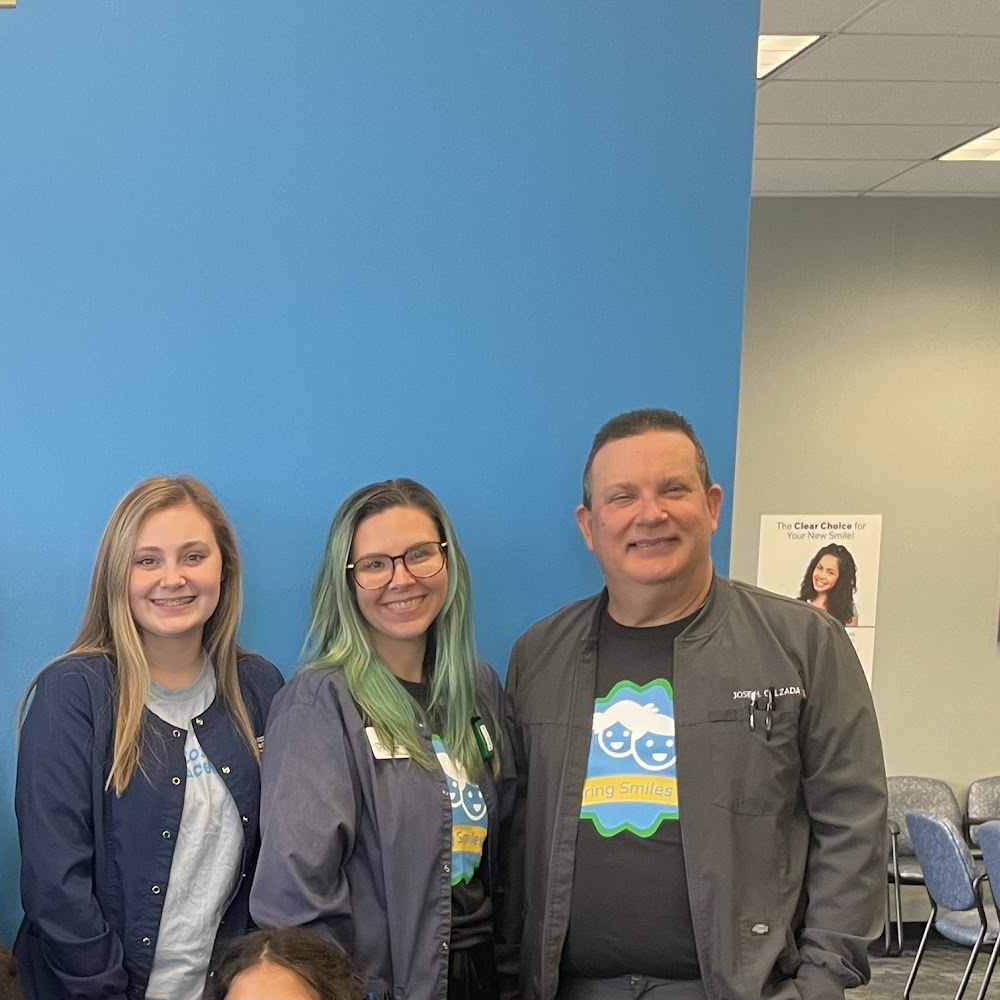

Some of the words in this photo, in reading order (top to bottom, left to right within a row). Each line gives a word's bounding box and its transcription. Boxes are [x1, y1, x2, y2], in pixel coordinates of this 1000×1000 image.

[777, 522, 792, 530] The
[794, 522, 818, 530] Clear
[820, 522, 852, 530] Choice
[854, 521, 866, 530] for
[787, 531, 806, 540] Your
[808, 531, 827, 540] New
[829, 531, 855, 540] Smile!
[763, 686, 800, 698] CLZADA
[619, 781, 673, 797] Smiles
